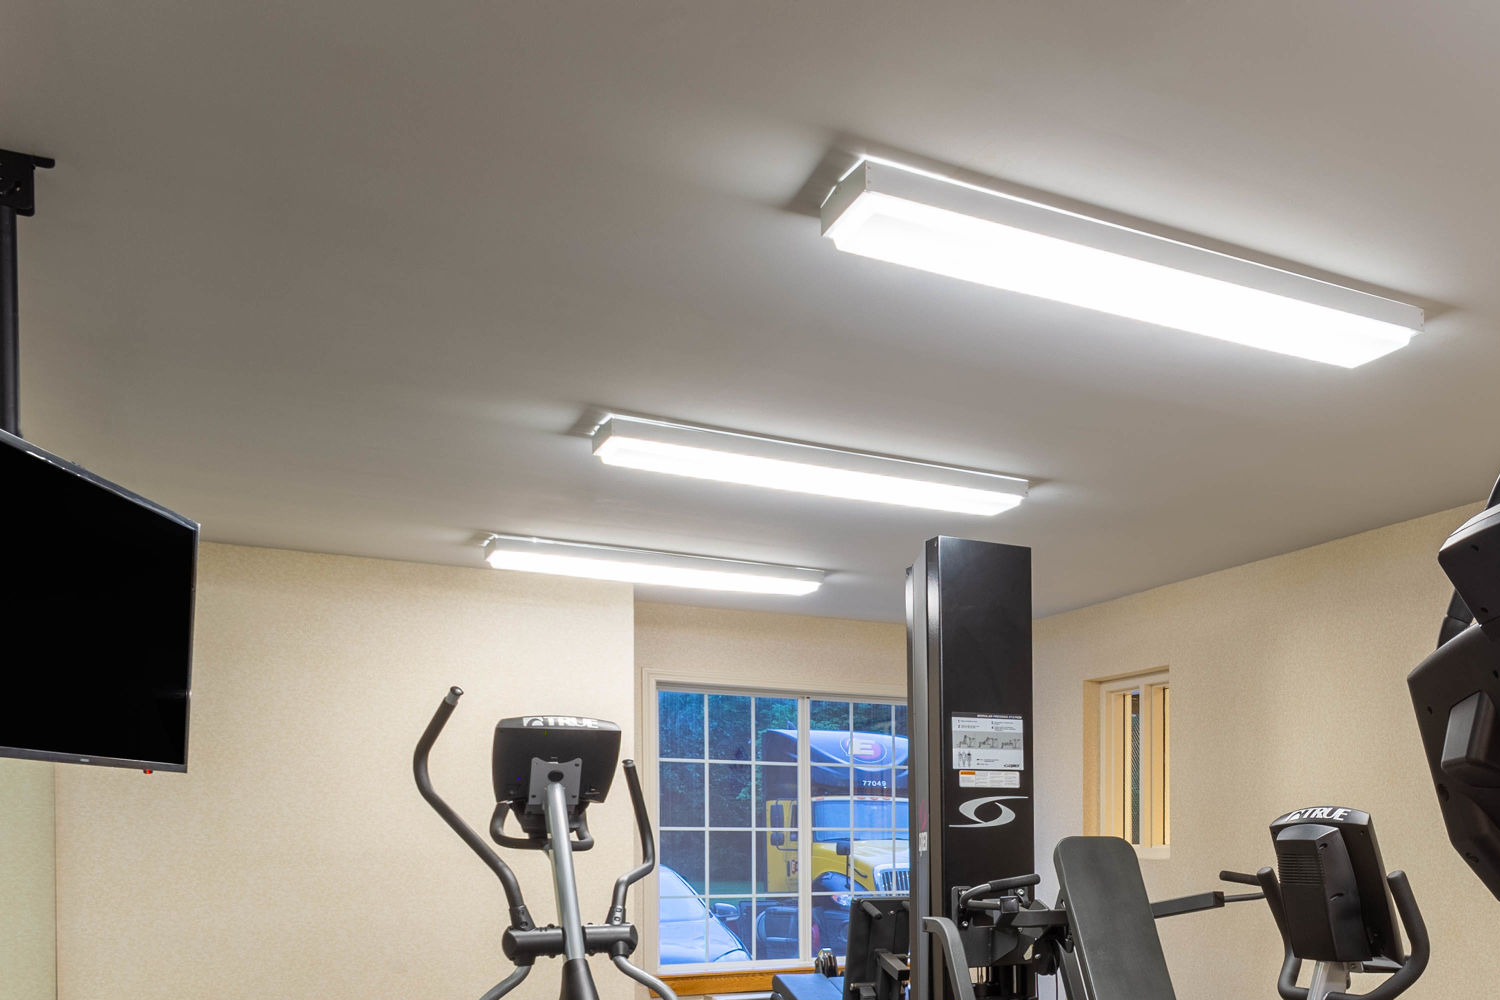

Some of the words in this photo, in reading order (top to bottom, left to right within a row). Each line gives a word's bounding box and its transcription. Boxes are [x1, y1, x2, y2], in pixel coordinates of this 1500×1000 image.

[545, 716, 599, 729] TRUE
[862, 779, 887, 787] 77049
[1302, 807, 1352, 821] TRUE
